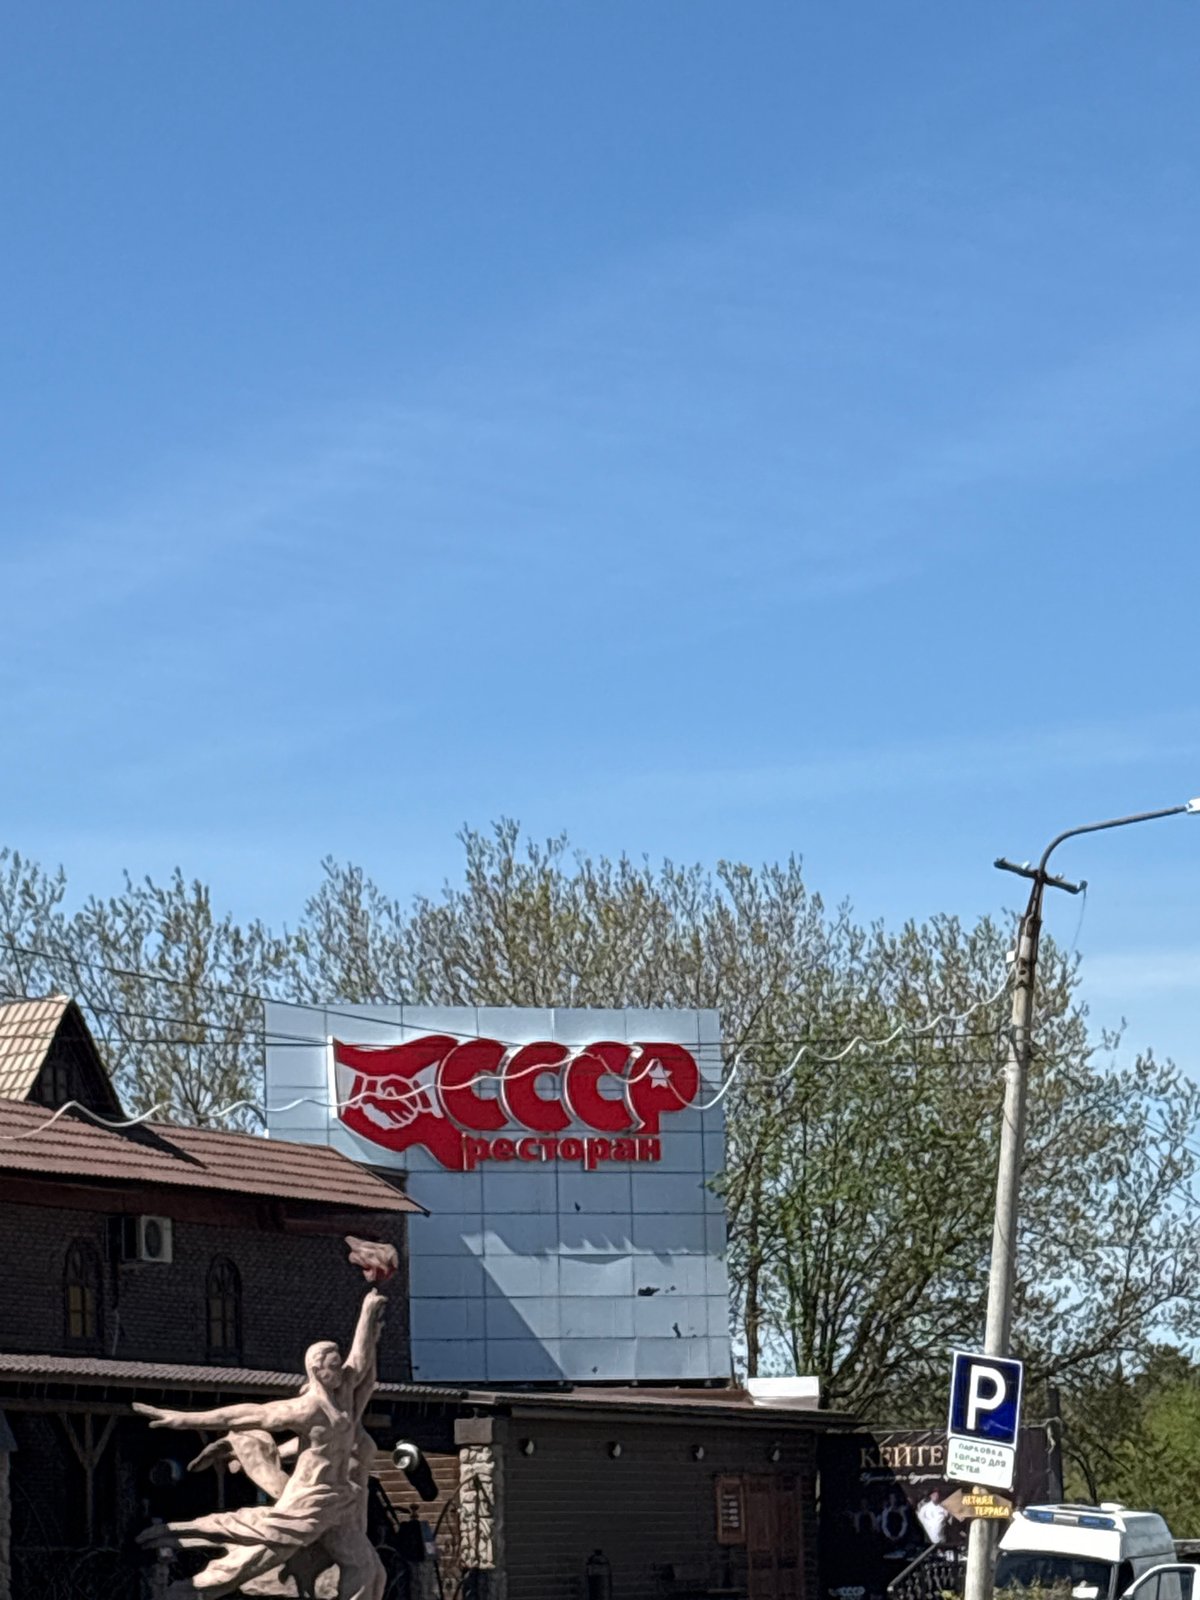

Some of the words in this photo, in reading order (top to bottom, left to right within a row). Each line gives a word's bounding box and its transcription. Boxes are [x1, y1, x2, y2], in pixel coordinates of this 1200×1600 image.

[437, 1038, 699, 1134] СССР
[463, 1136, 661, 1171] ресторан
[966, 1364, 1006, 1431] P
[860, 1443, 948, 1468] КЕЙТЕ
[954, 1452, 987, 1465] ТОЛЬКО
[988, 1458, 1006, 1468] ДЛЯ
[959, 1443, 1003, 1457] ПАРКОВКА
[974, 1505, 1010, 1517] ТЕРРАСА
